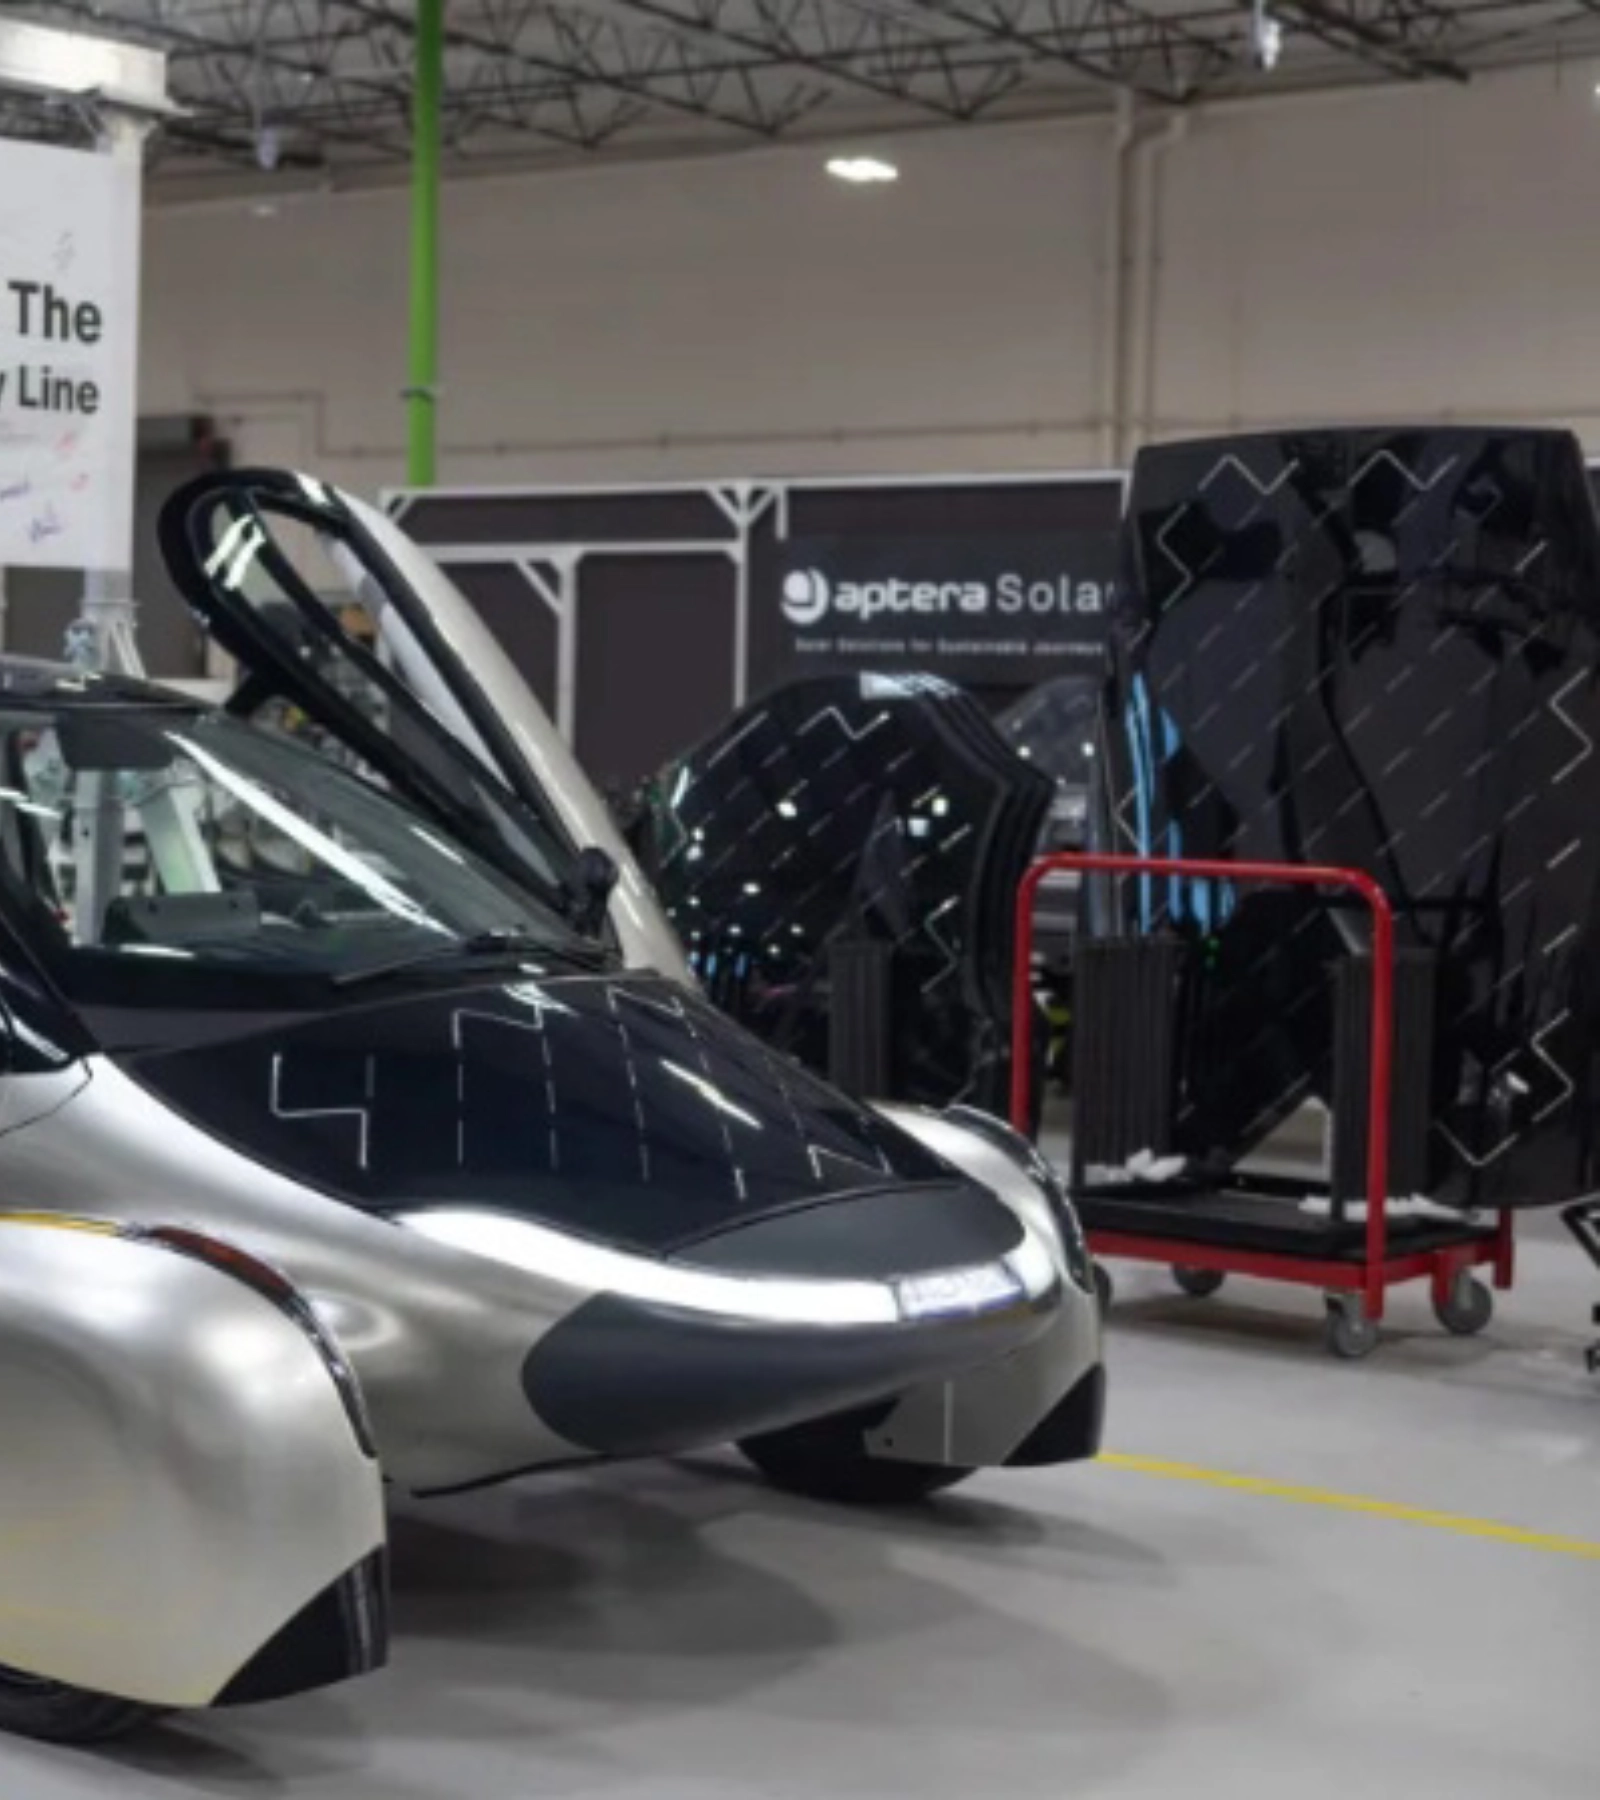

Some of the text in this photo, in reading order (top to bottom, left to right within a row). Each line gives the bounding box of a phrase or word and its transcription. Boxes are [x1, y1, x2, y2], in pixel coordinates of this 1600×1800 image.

[7, 279, 103, 345] The
[17, 364, 99, 416] Line
[834, 577, 988, 621] aptera
